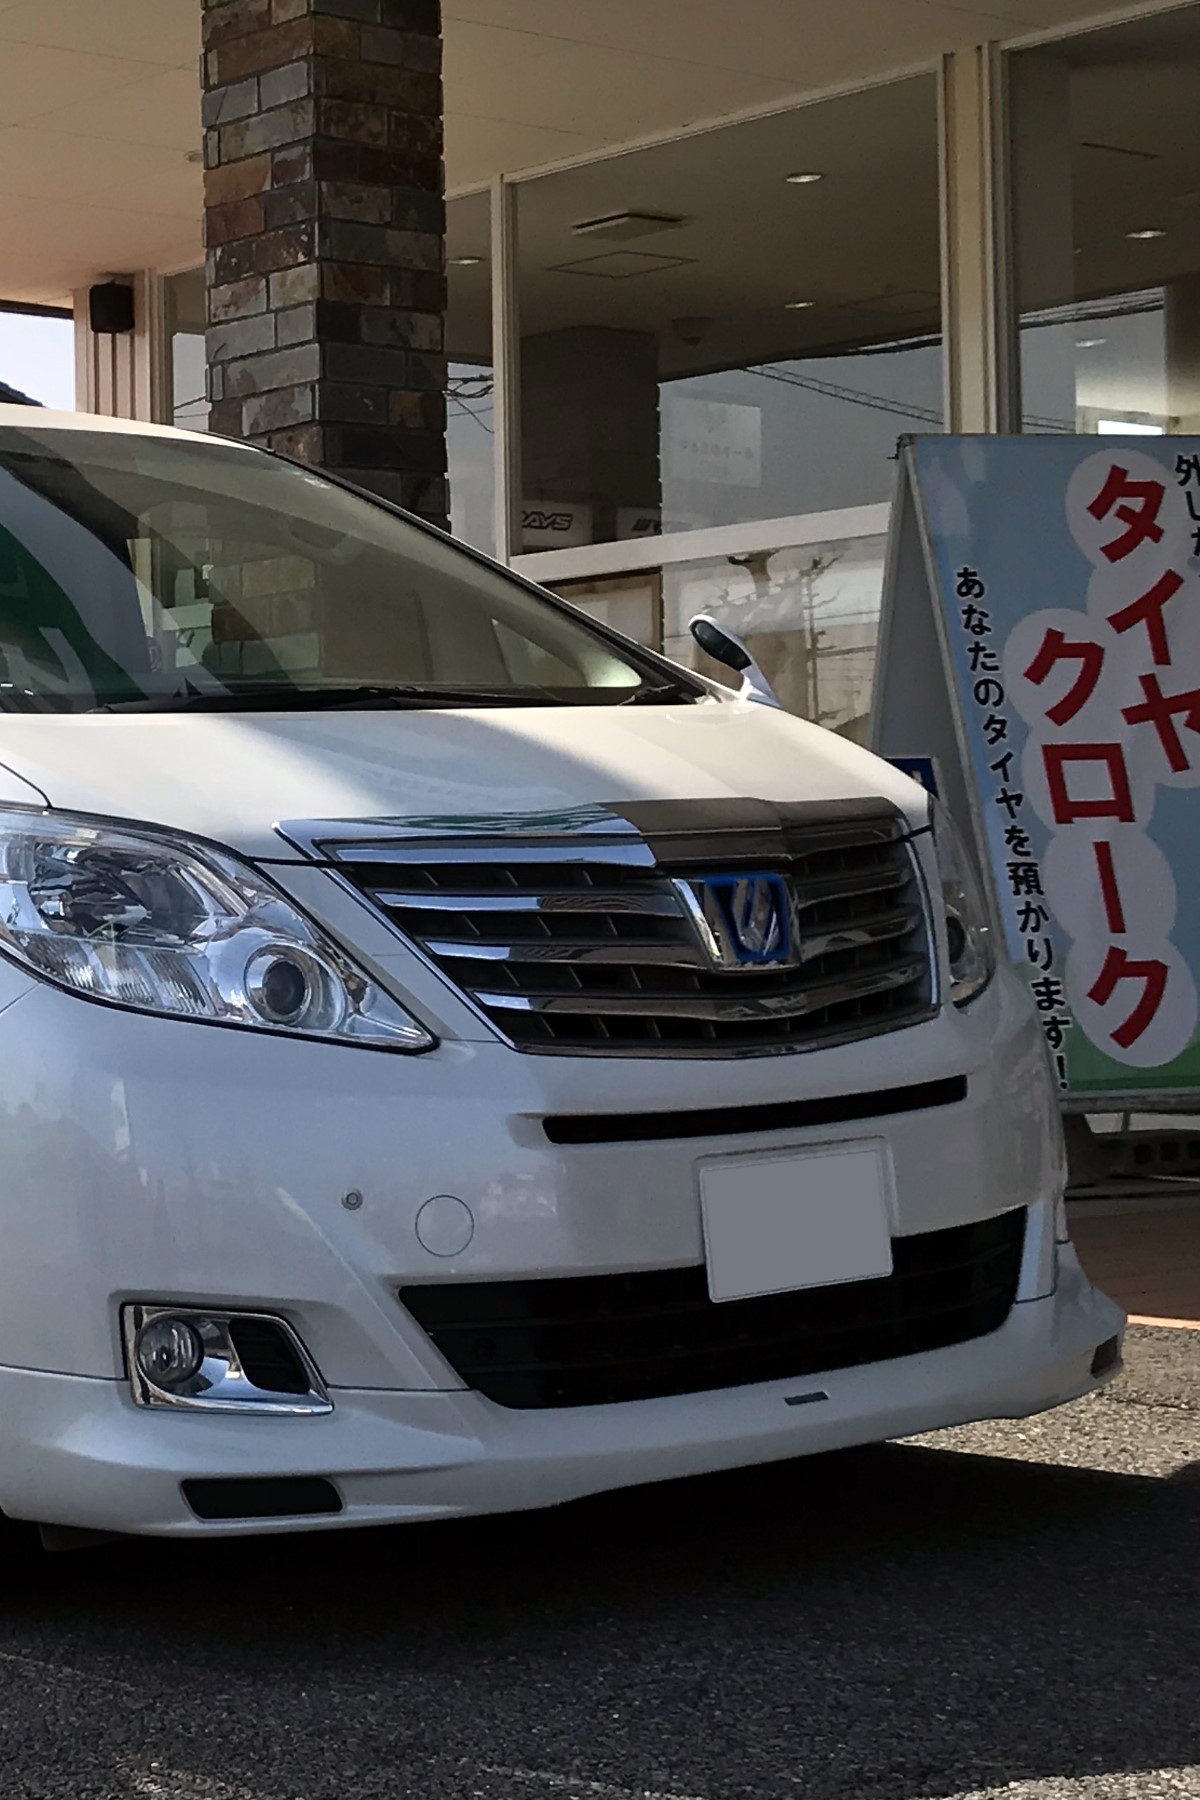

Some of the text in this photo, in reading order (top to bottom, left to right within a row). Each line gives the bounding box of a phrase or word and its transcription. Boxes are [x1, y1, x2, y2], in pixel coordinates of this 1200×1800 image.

[956, 567, 1070, 1089] あなたのタイヤを預かります!
[1087, 464, 1200, 772] タイヤ
[1023, 628, 1169, 1049] クローク
